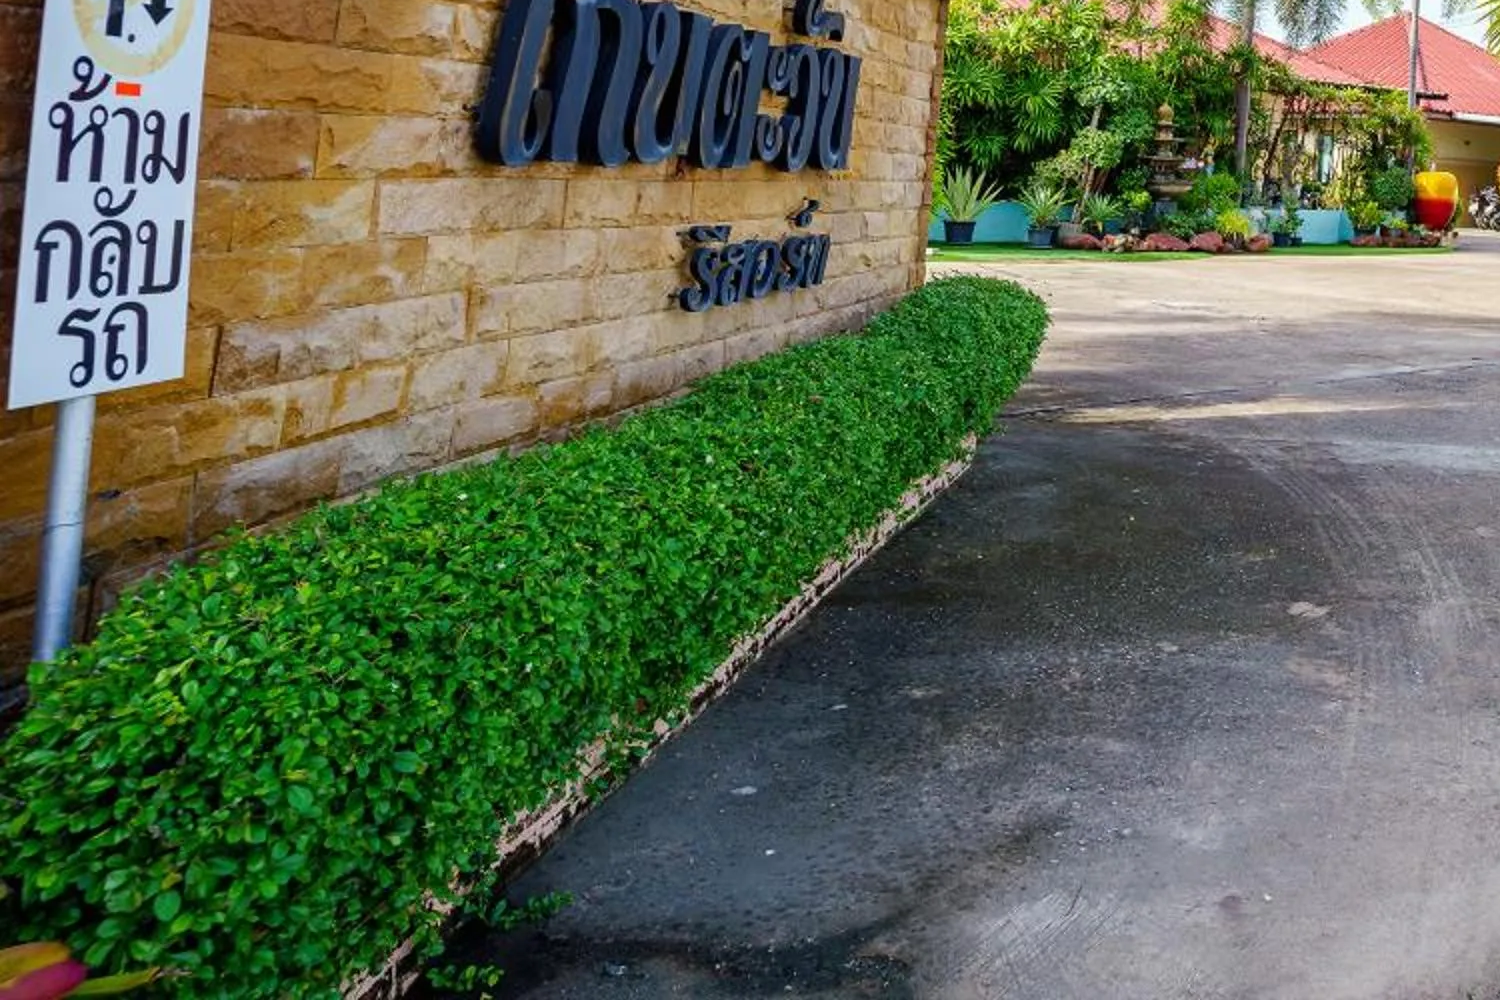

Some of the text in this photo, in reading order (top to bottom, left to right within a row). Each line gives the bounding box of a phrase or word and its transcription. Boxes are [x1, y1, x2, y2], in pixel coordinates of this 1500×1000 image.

[47, 55, 191, 186] ห้าม
[33, 186, 185, 303] กลับ
[57, 301, 149, 388] รถ
